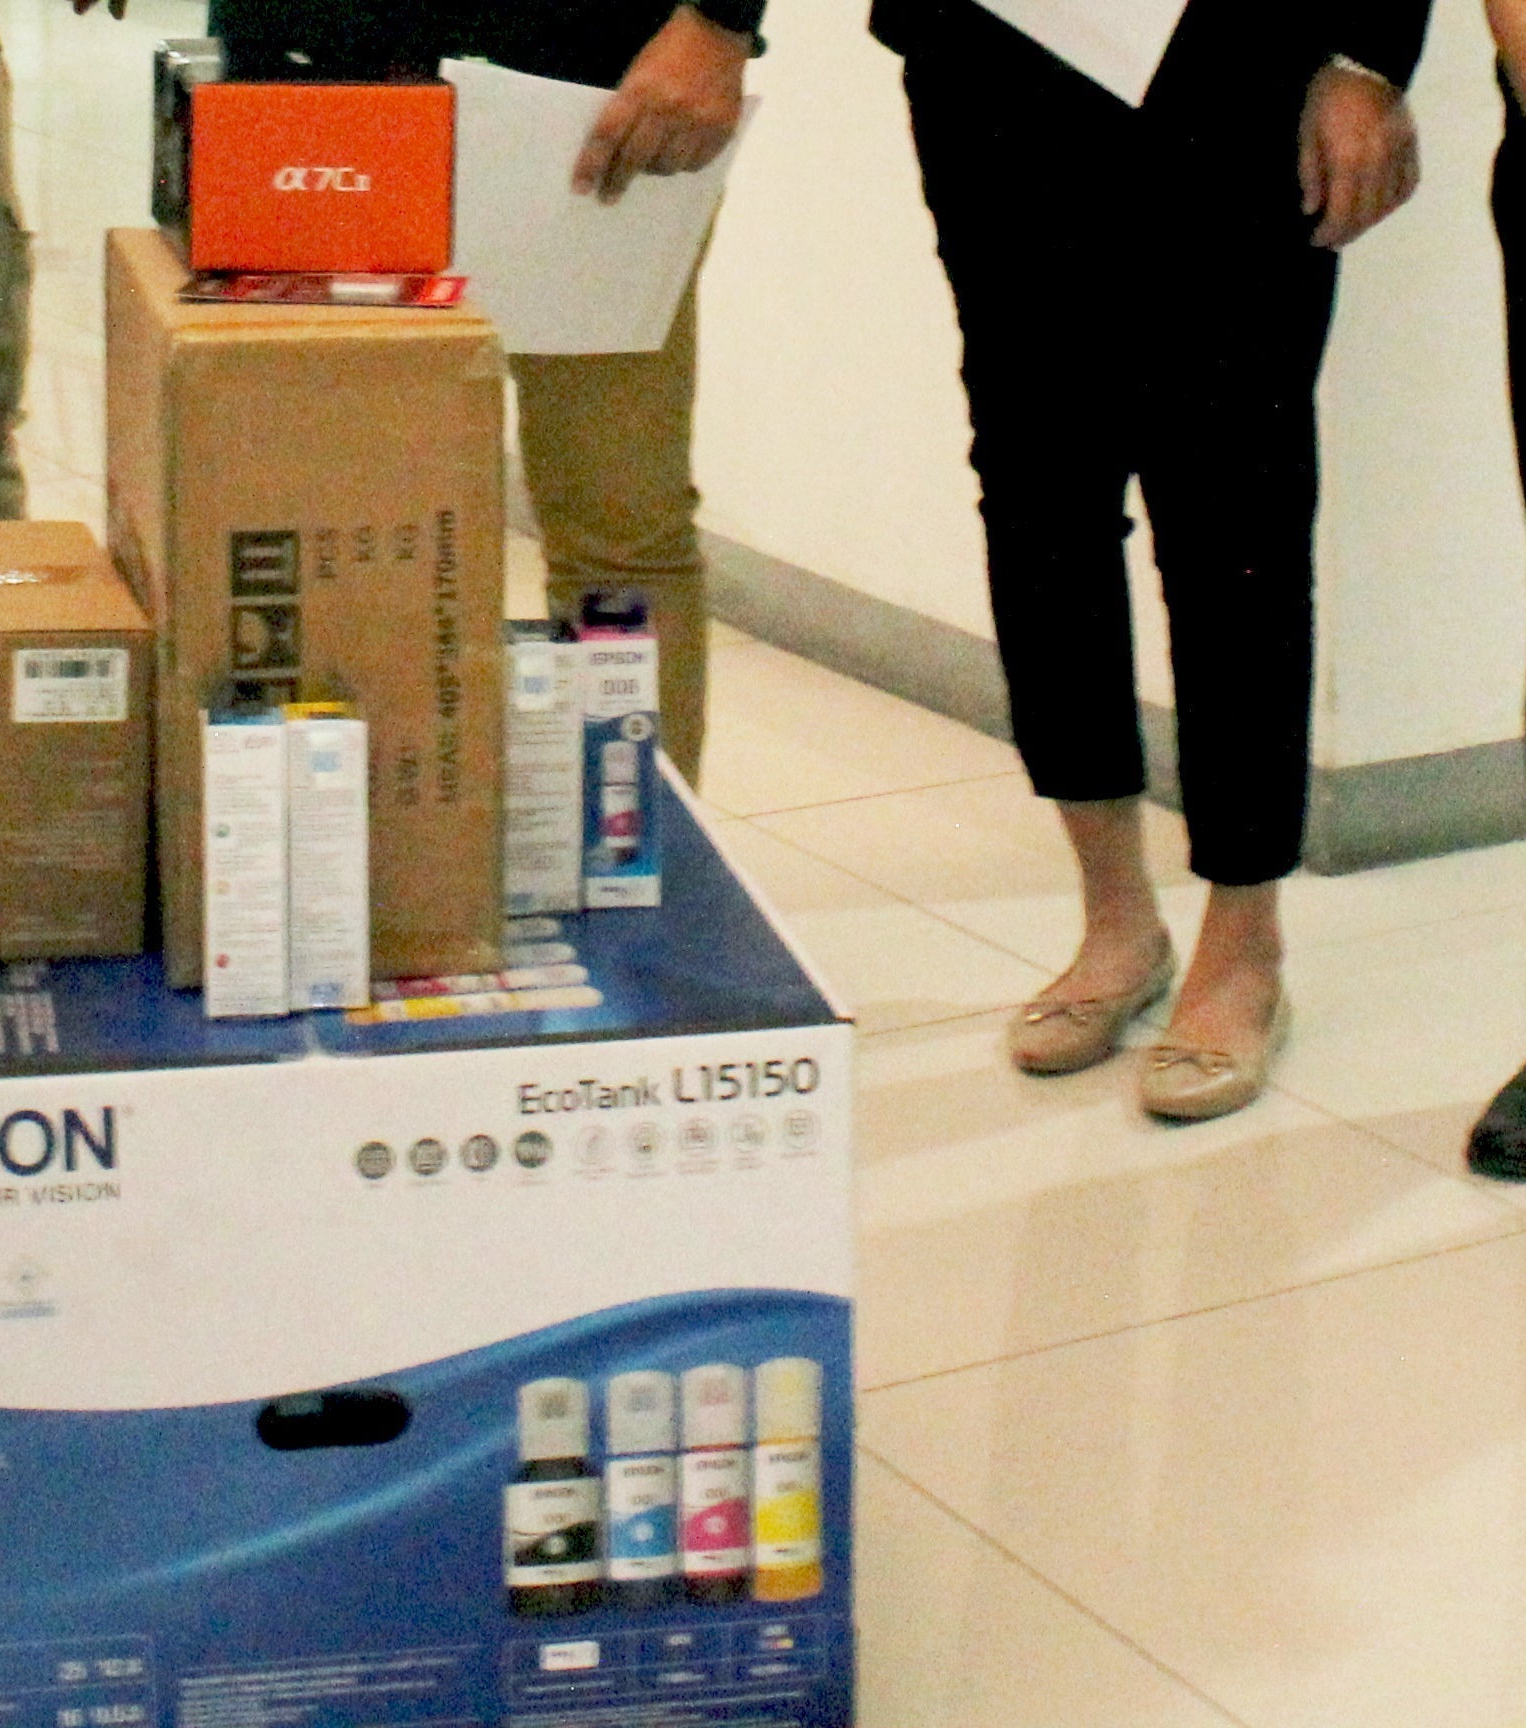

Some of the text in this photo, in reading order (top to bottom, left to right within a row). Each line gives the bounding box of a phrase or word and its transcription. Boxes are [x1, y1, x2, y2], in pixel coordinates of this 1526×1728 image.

[518, 1056, 823, 1115] EcoTank L15150
[28, 1181, 122, 1205] VISION
